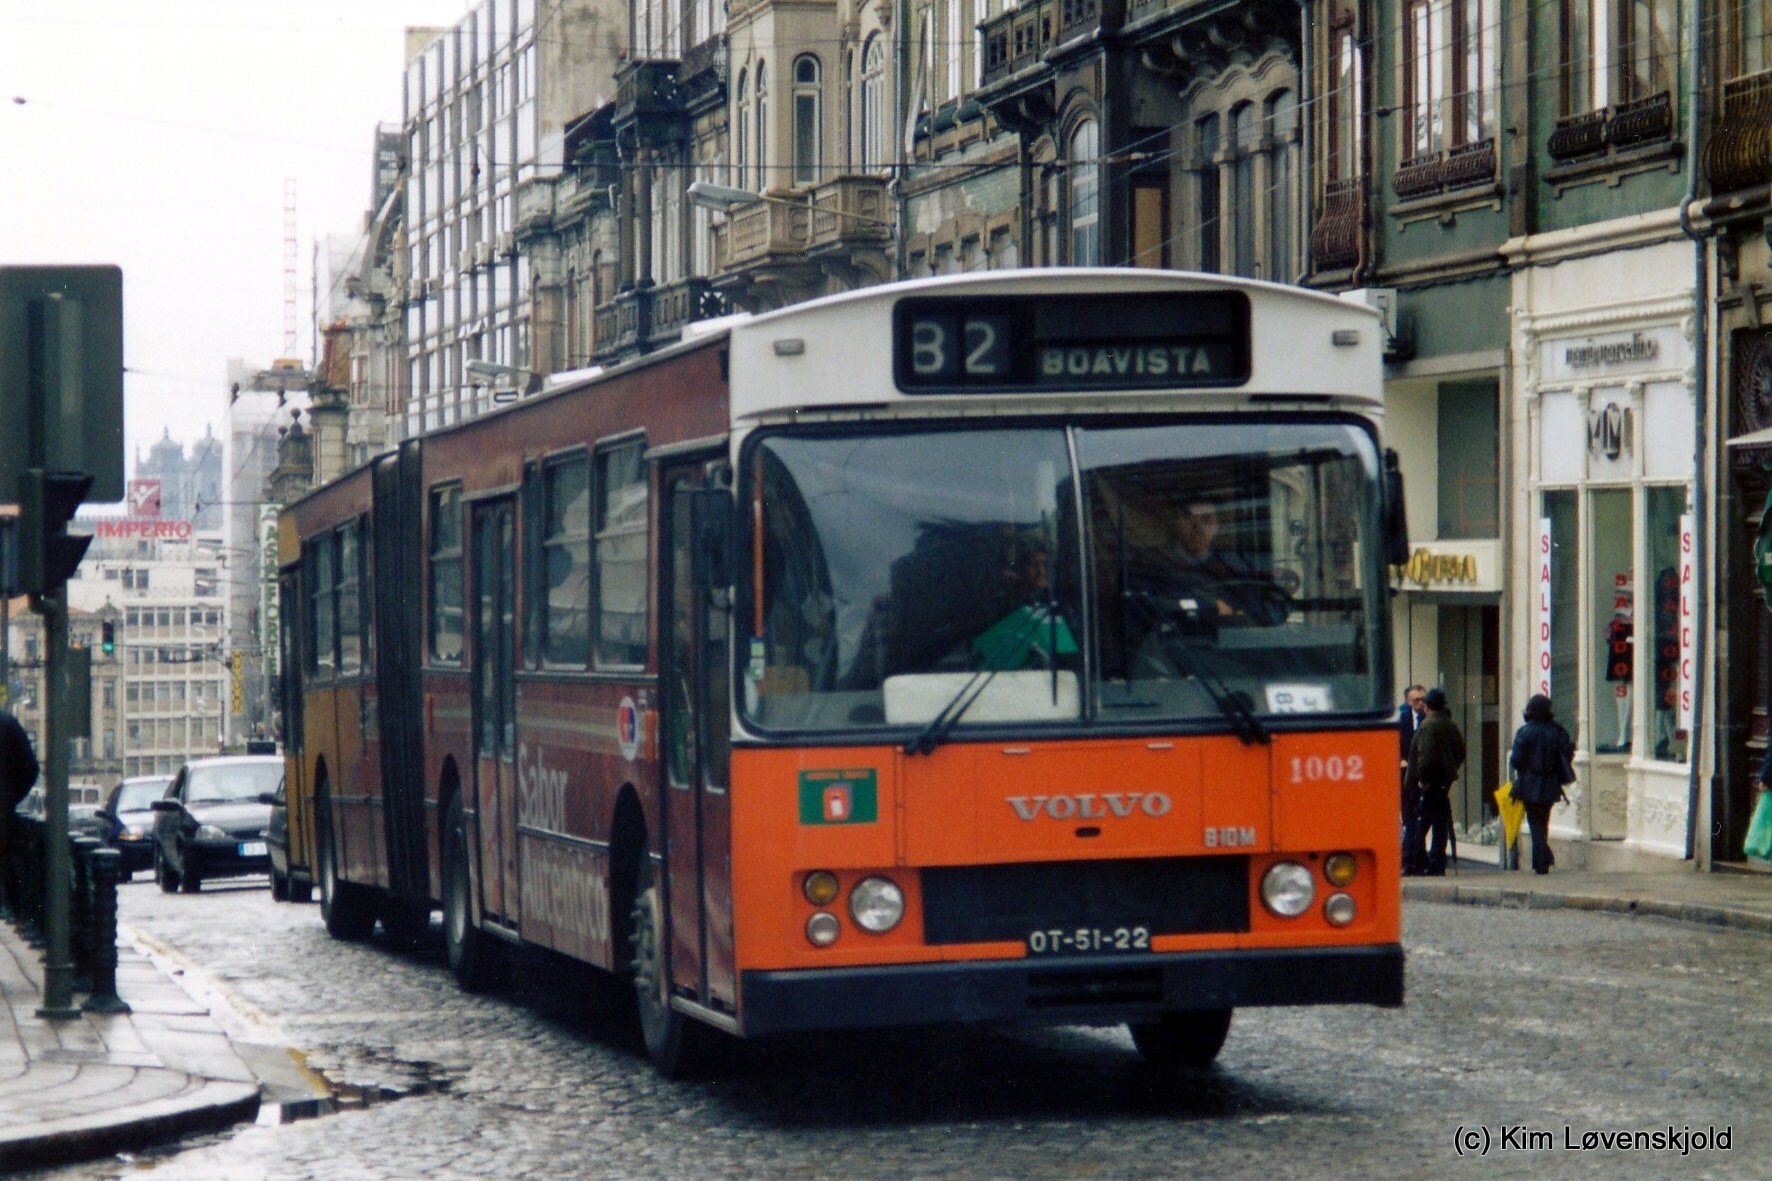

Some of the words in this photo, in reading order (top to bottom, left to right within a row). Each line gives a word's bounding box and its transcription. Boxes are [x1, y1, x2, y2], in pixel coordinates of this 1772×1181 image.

[1042, 348, 1211, 376] BOAVISTA
[1541, 534, 1550, 697] SALDOS
[1290, 756, 1365, 783] 1002
[519, 743, 568, 833] Sabor
[1006, 792, 1172, 821] VOLVO
